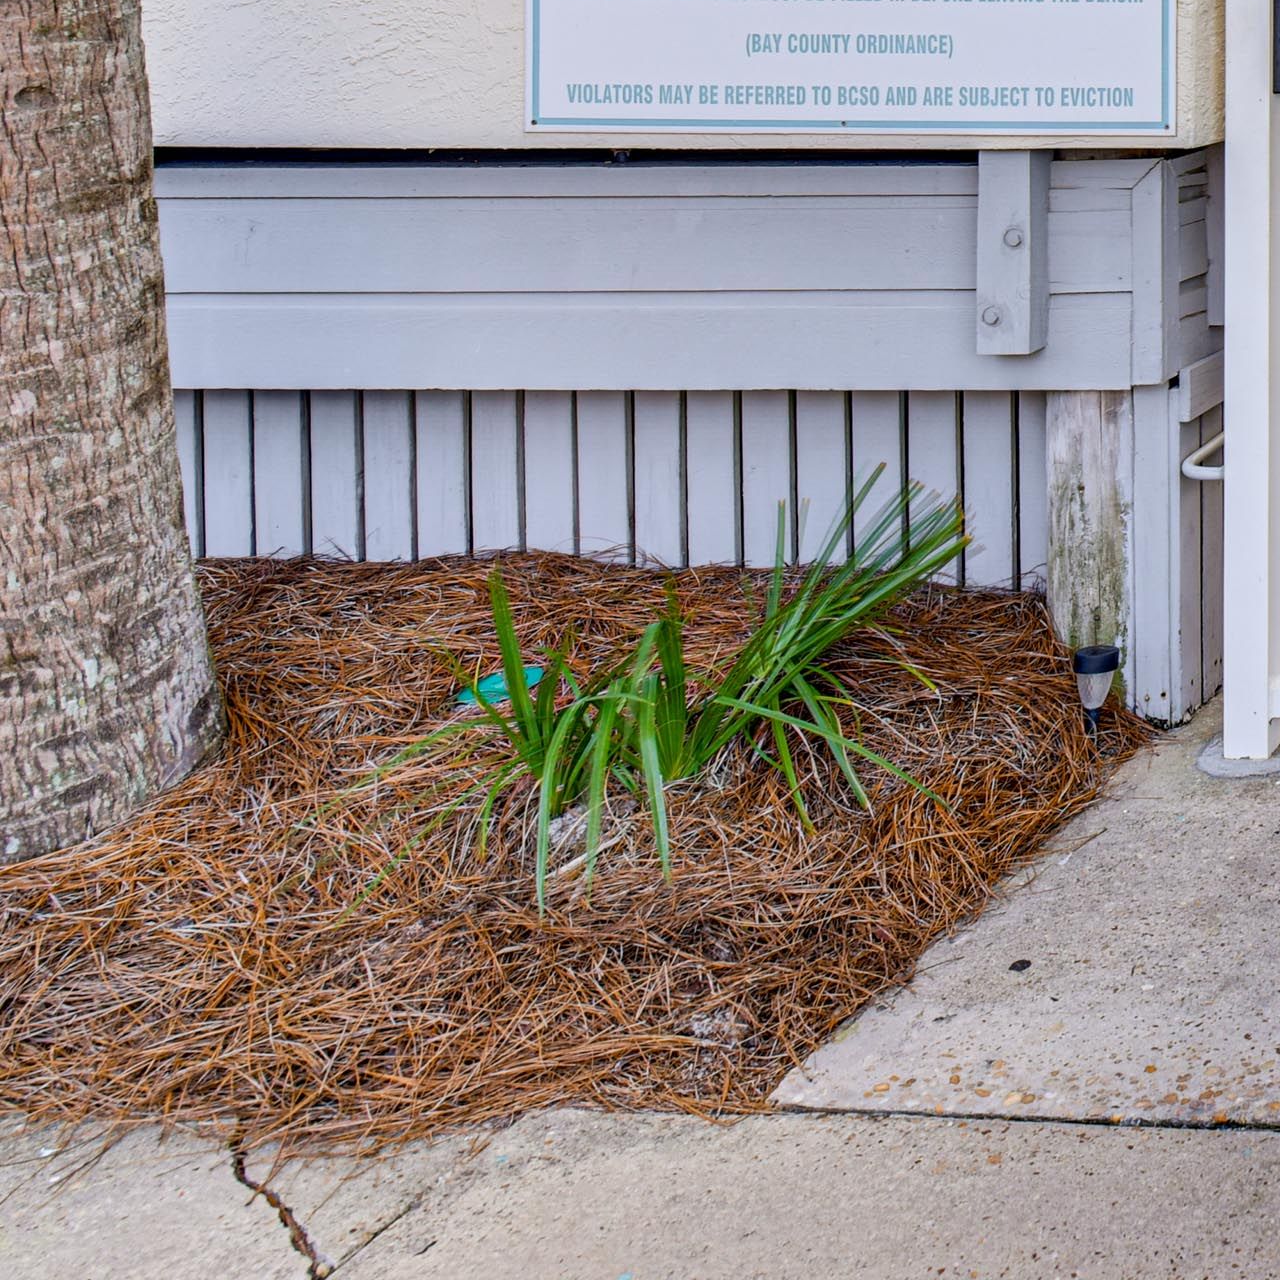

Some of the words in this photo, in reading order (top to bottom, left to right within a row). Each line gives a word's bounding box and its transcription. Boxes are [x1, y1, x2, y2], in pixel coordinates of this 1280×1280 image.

[745, 33, 783, 58] (BAY
[787, 33, 852, 54] COUNTY
[855, 33, 954, 59] ORDINANCE)
[565, 83, 654, 105] VIOLATORS
[658, 84, 694, 105] MAY
[698, 84, 719, 105] BE
[723, 84, 807, 106] REFERRED
[811, 85, 832, 107] TO
[837, 85, 881, 107] BCSO
[884, 85, 918, 107] AND
[921, 86, 954, 107] ARE
[958, 86, 1031, 107] SUBJECT
[1034, 86, 1056, 108] TO
[1060, 86, 1134, 108] EVICTION
